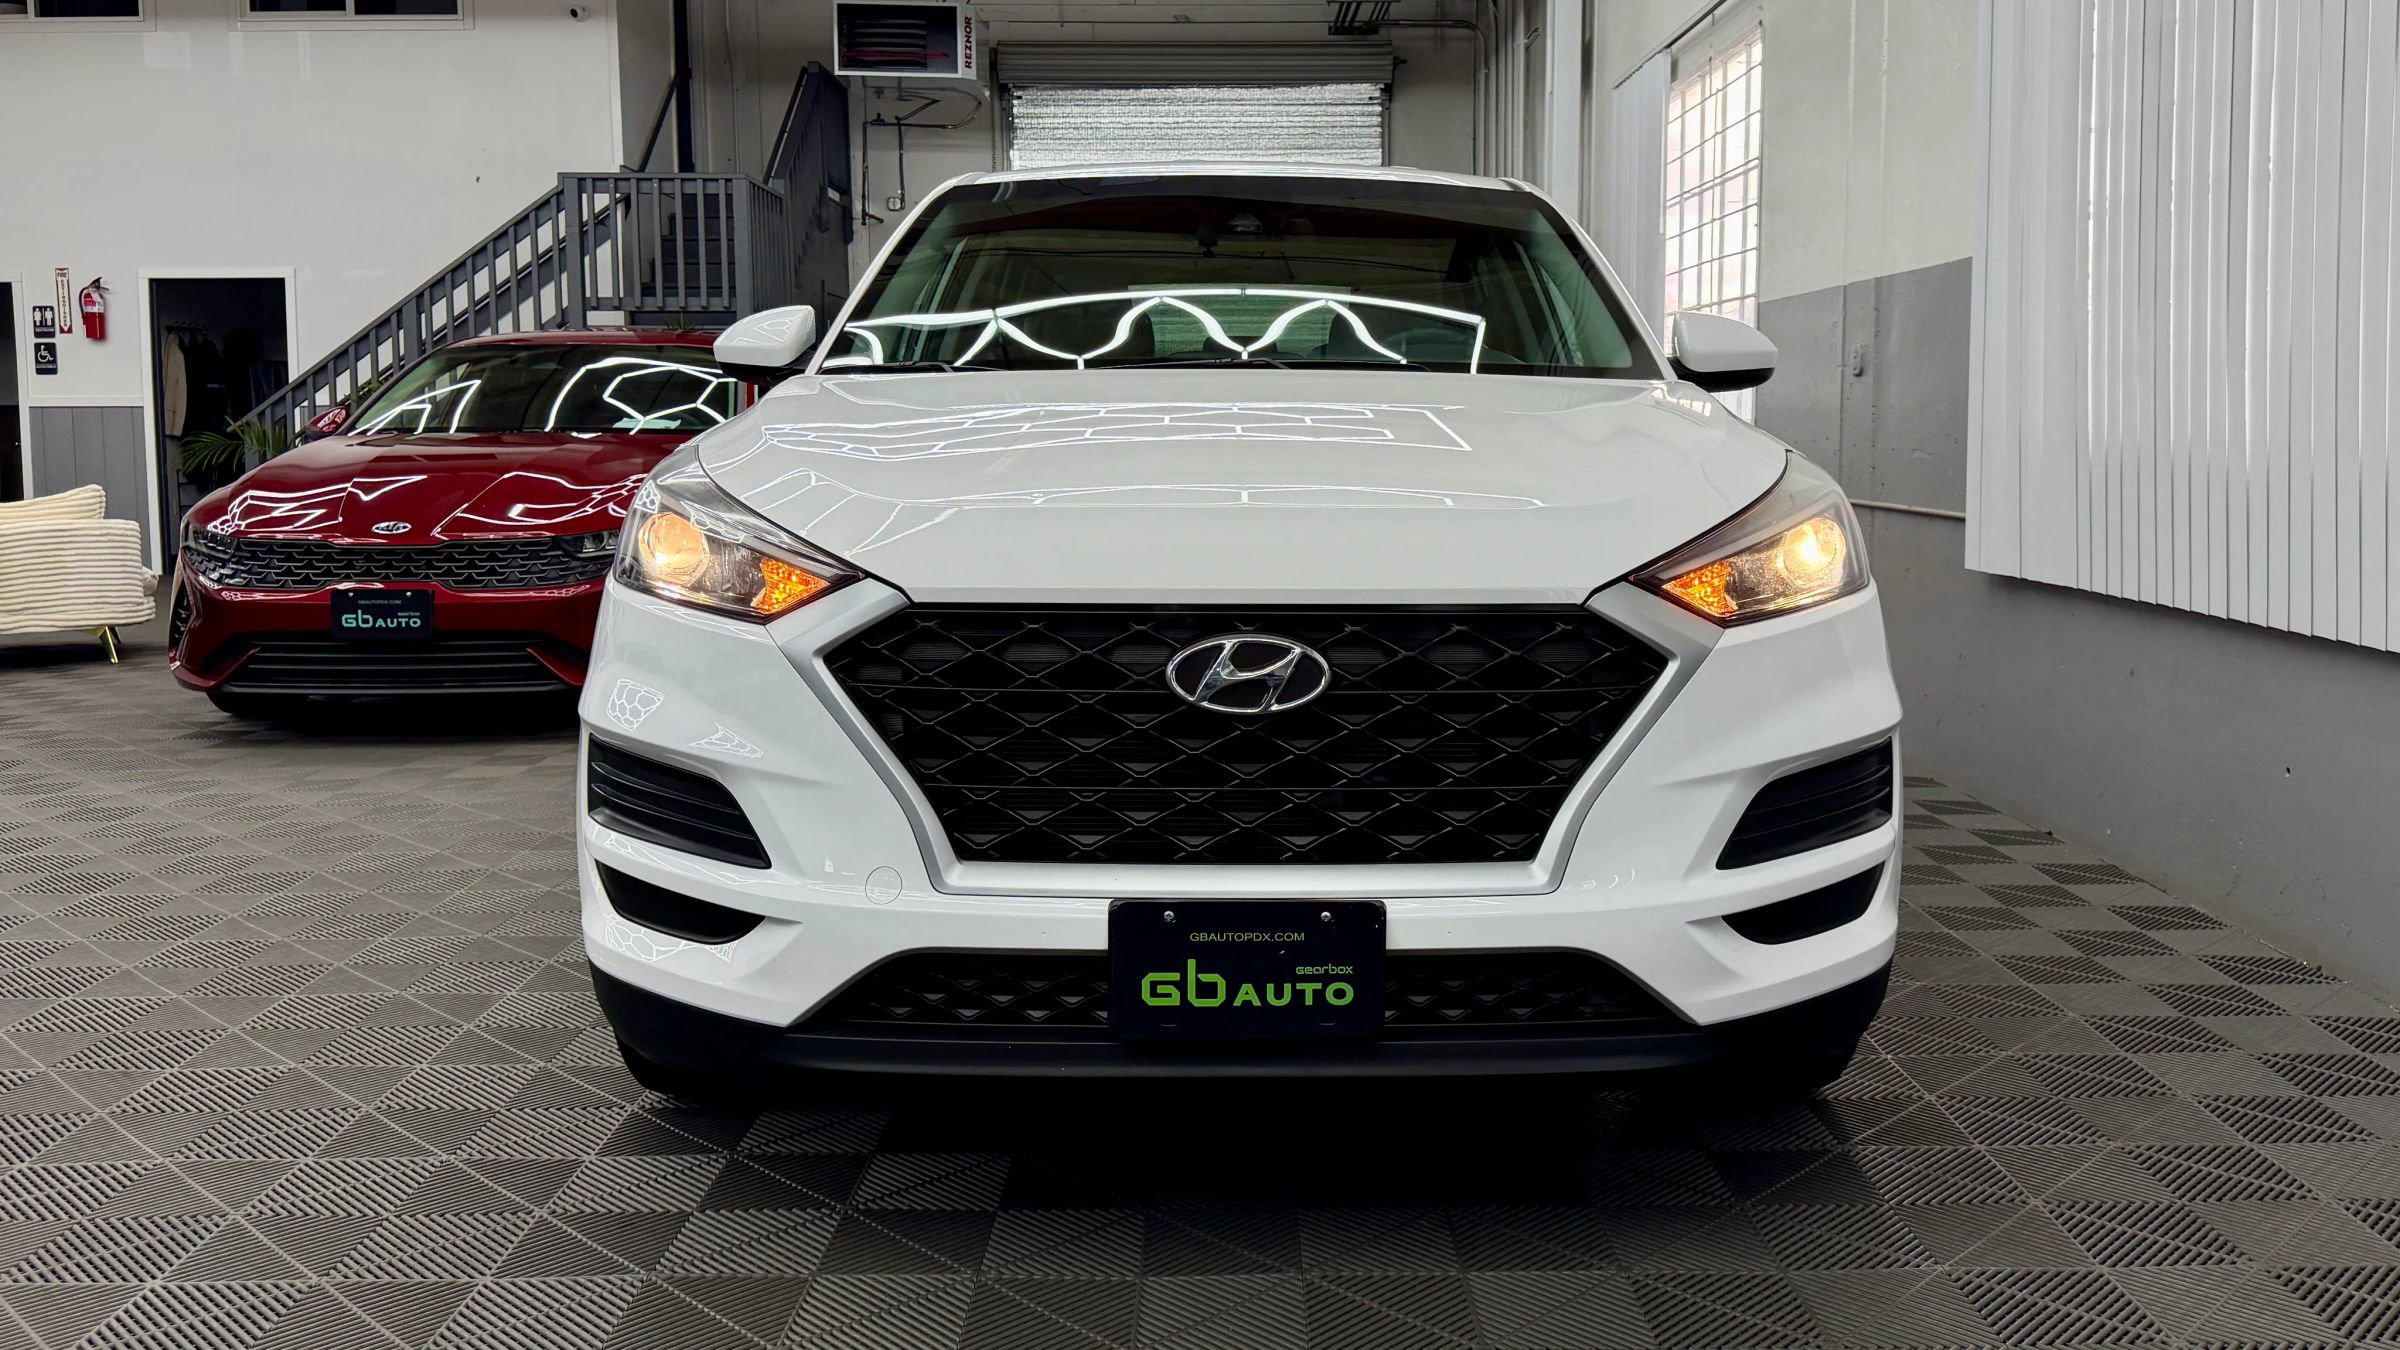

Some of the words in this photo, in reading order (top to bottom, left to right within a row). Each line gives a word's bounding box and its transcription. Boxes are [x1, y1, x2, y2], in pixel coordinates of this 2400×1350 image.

[964, 16, 973, 69] REZNOR
[375, 618, 421, 628] AUTO
[1189, 932, 1305, 942] GBAUTOPDX.COM
[1232, 981, 1354, 1007] AUTO
